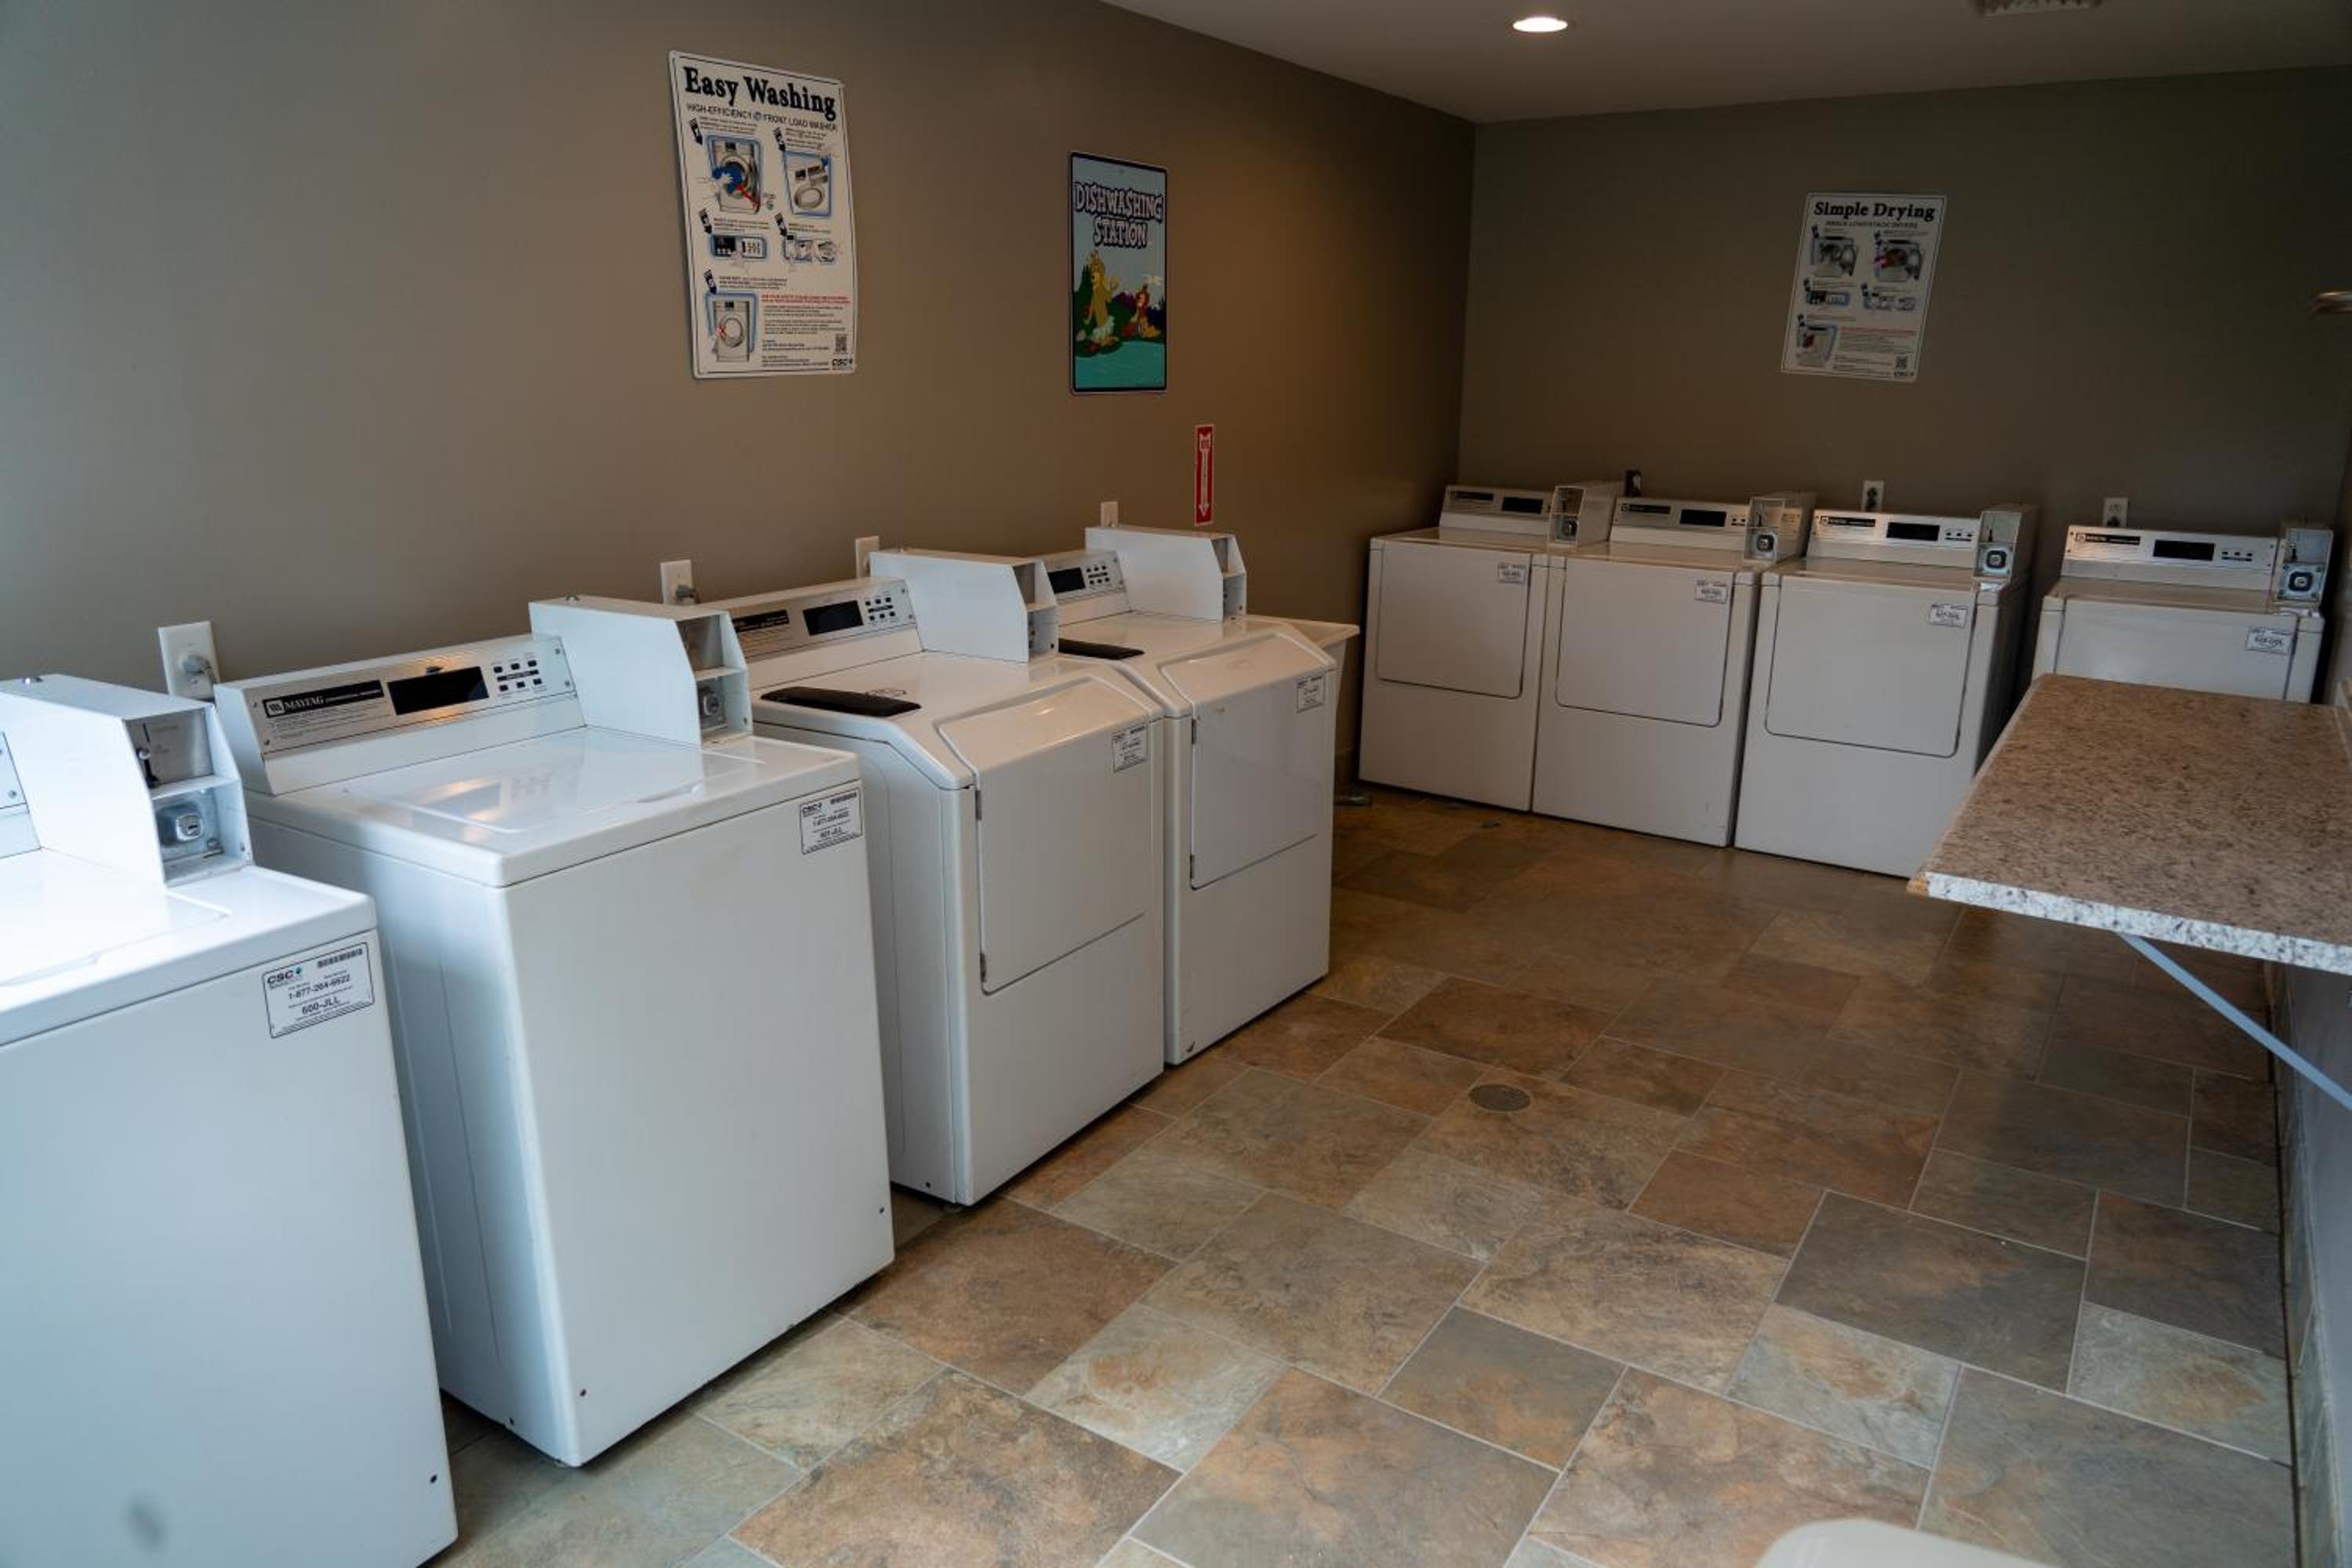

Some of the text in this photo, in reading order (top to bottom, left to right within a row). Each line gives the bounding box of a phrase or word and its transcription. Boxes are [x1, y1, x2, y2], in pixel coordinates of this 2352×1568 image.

[683, 66, 837, 122] Easy Washing
[687, 103, 752, 119] HIGH-EFFICIENCY
[1075, 182, 1163, 223] DISHWASHING
[1813, 201, 1935, 222] Simple Drying
[1094, 218, 1147, 248] STATION
[267, 970, 294, 984] CSC
